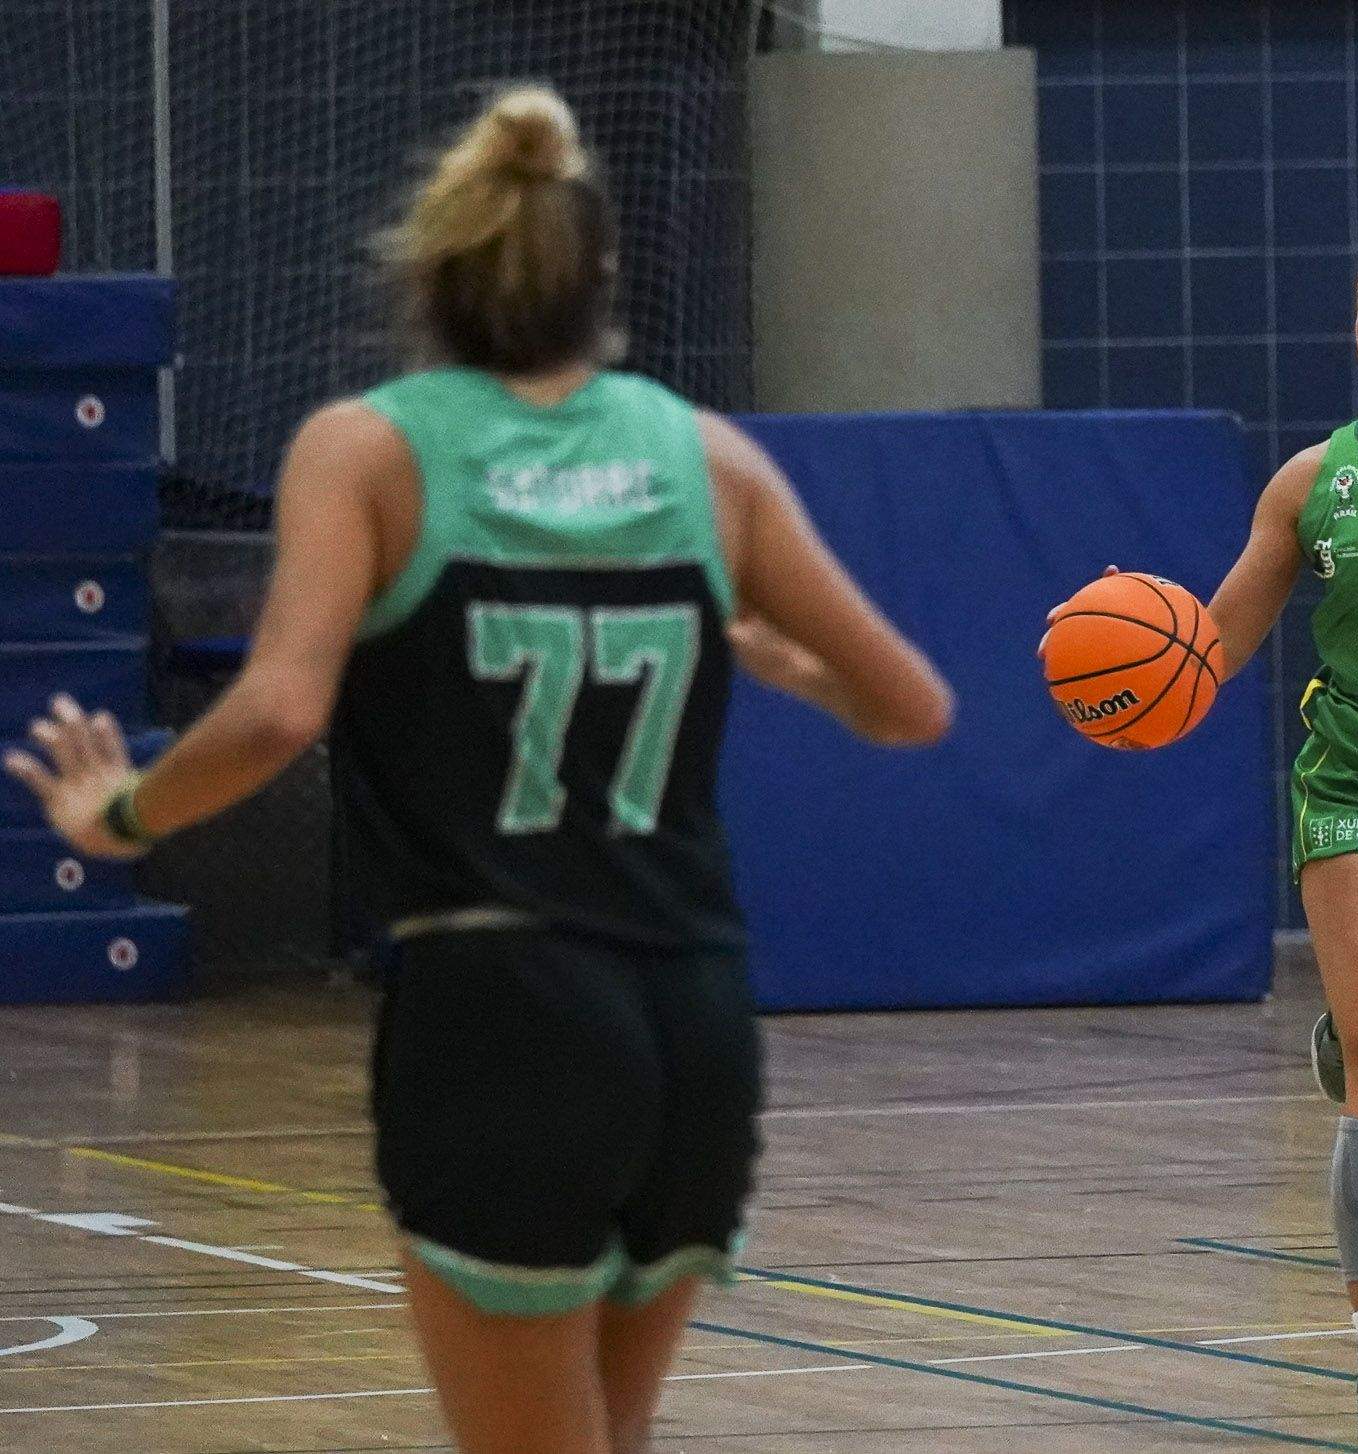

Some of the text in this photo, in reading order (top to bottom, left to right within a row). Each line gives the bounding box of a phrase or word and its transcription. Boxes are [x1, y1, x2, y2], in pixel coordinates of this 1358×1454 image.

[466, 601, 699, 835] 77
[1057, 687, 1141, 724] ilson
[1336, 829, 1352, 841] DE
